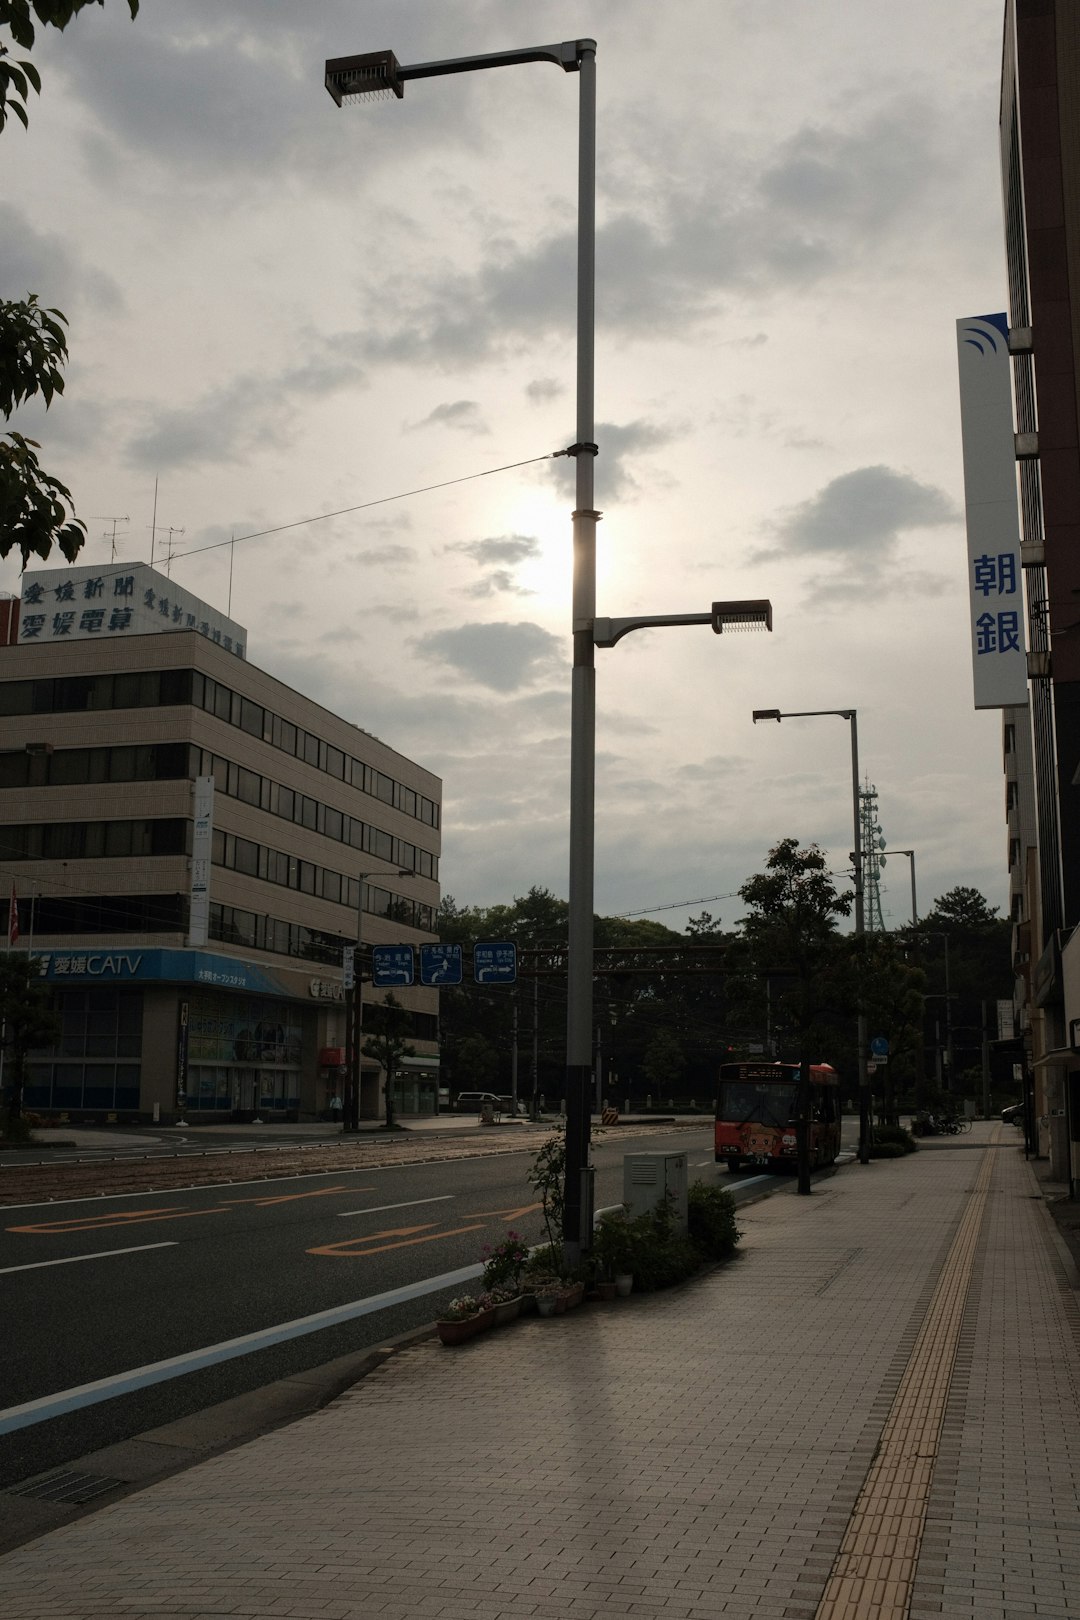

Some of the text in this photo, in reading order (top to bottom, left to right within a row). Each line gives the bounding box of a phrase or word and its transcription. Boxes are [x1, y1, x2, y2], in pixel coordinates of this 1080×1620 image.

[24, 576, 134, 604] 愛媛新聞
[973, 553, 1020, 656] 朝銀
[20, 607, 135, 639] 愛媛電算
[54, 955, 142, 975] 愛媛CATV
